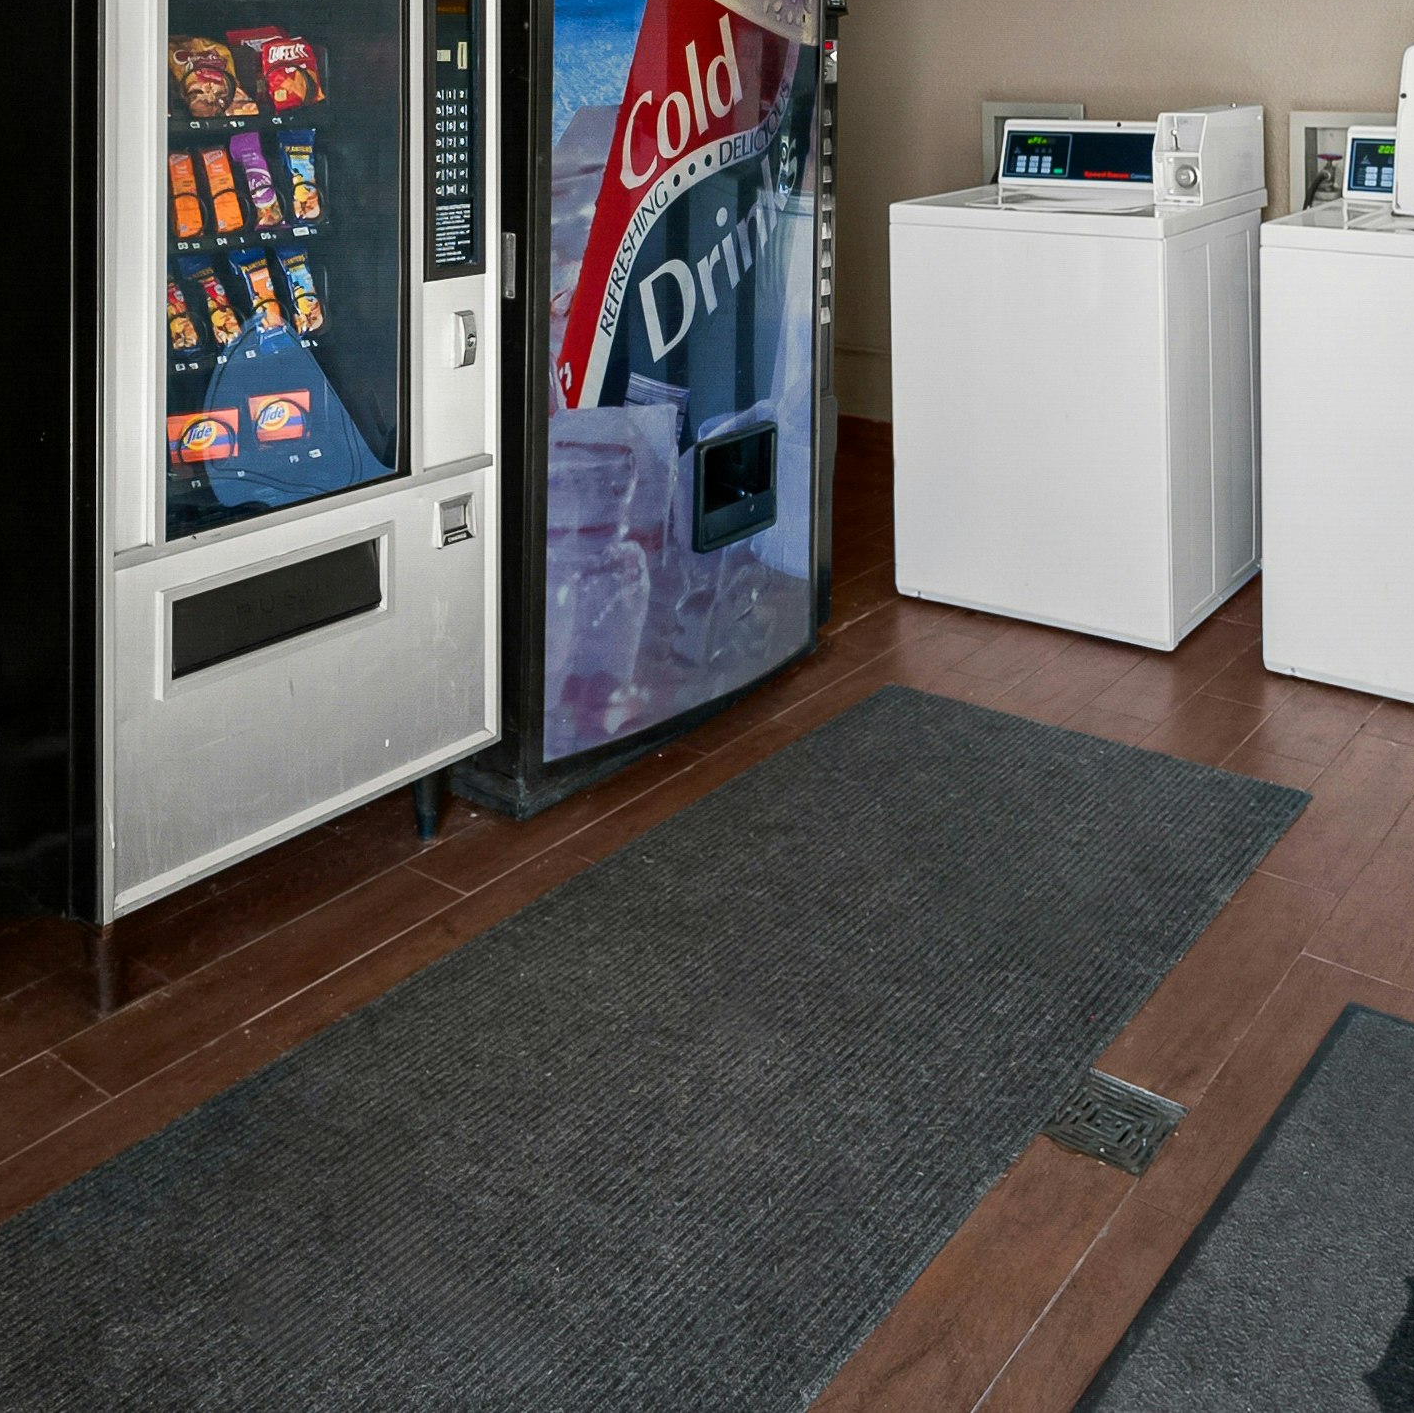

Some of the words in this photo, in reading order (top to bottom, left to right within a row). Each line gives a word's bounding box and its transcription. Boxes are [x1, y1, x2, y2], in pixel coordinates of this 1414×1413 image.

[619, 13, 743, 191] Cold
[719, 80, 791, 167] DELICIOUS
[598, 179, 670, 338] REFRESHING
[186, 424, 213, 445] Tide
[260, 406, 286, 425] Tide
